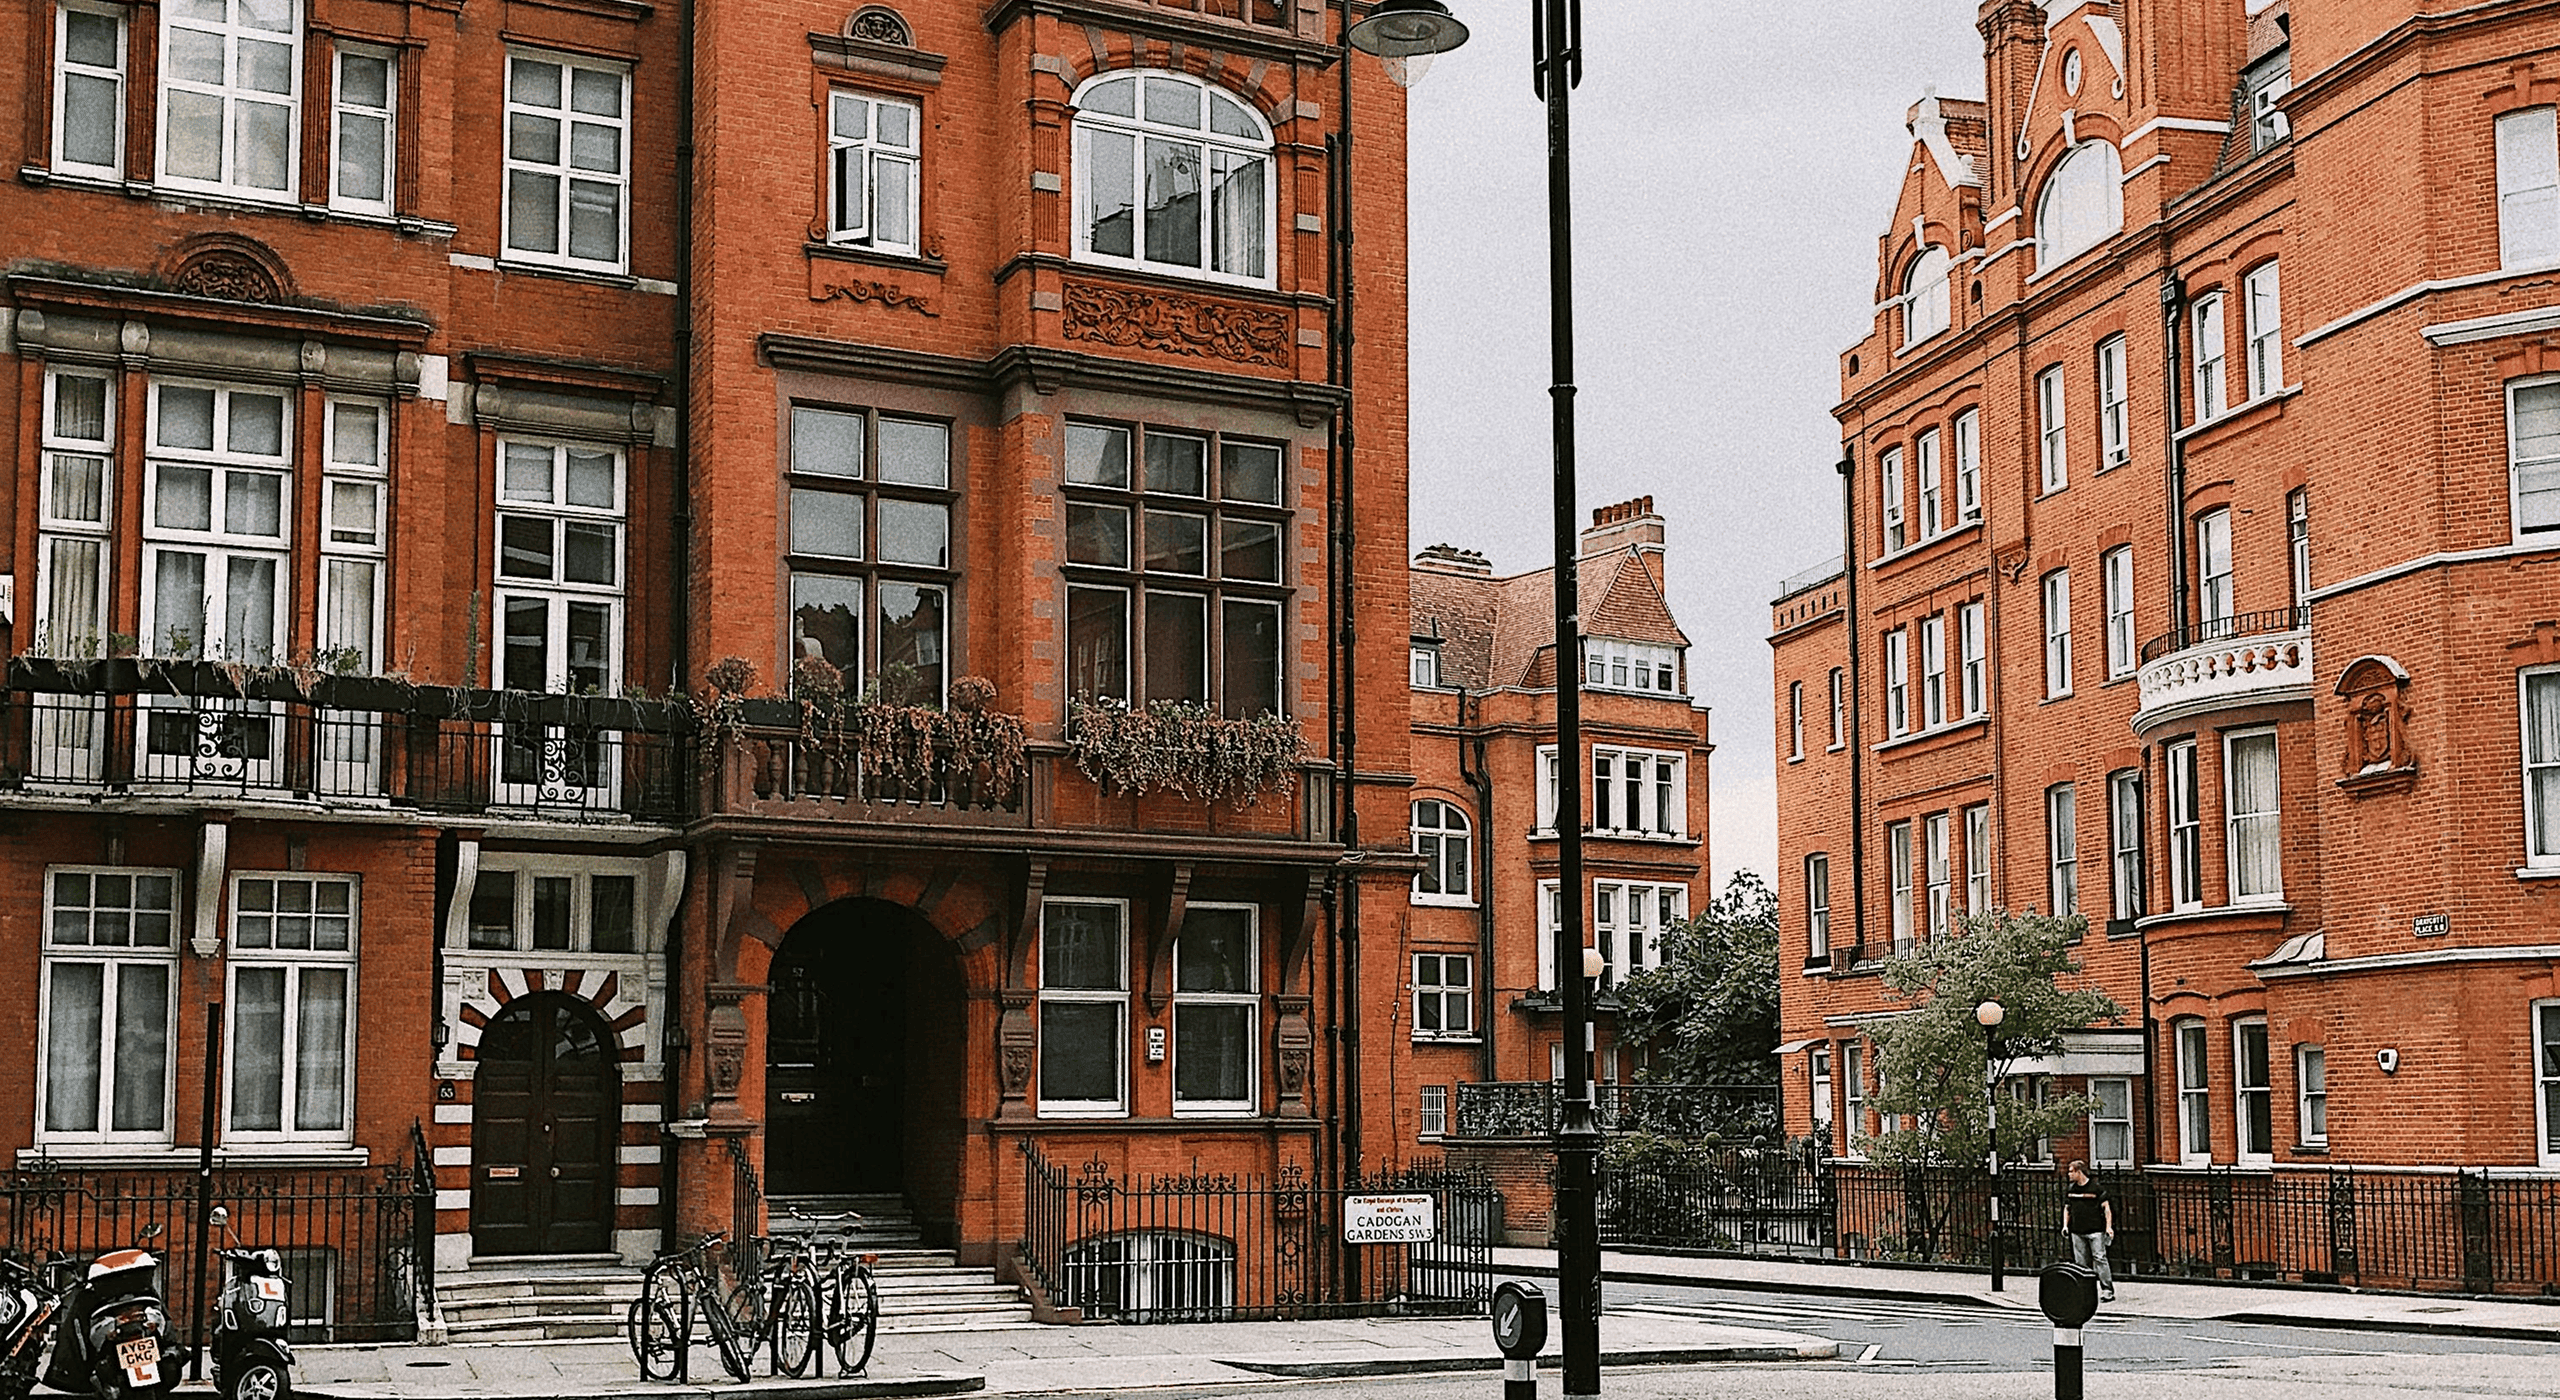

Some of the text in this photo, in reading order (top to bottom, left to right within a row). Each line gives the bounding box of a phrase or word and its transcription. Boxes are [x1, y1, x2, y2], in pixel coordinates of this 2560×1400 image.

[440, 1087, 454, 1098] 55
[1357, 1215, 1422, 1227] CADOGAN
[1347, 1228, 1432, 1241] GARDENS SW3
[263, 1282, 278, 1295] L
[121, 1339, 155, 1355] AY63
[134, 1367, 152, 1381] L
